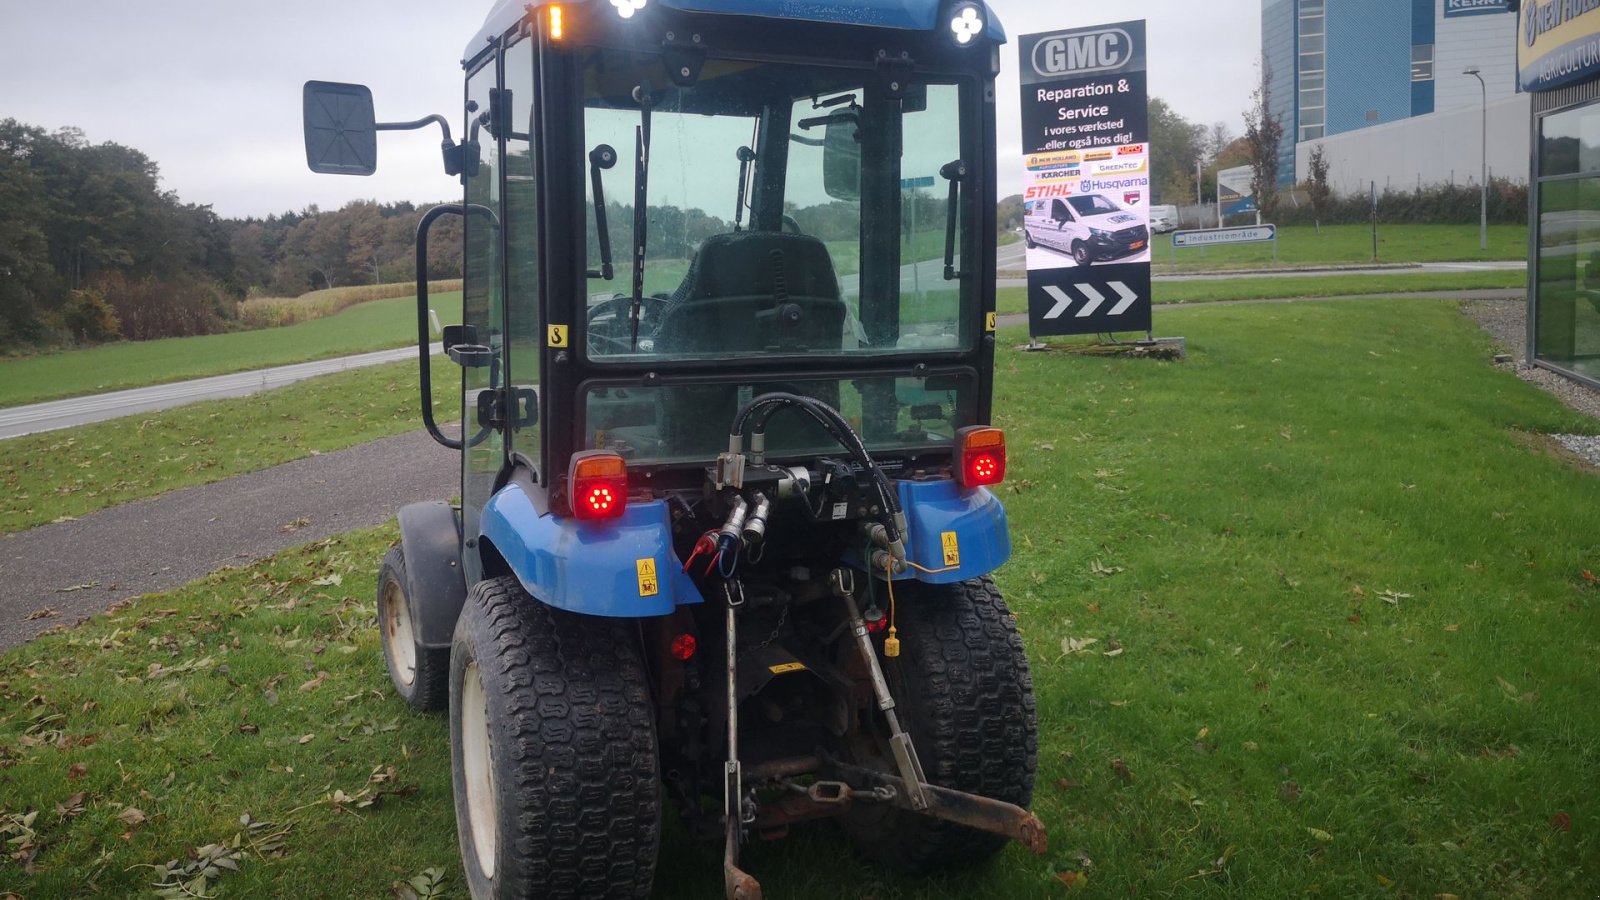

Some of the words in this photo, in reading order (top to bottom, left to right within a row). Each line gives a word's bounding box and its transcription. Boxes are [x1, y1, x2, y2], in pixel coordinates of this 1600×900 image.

[1045, 33, 1119, 73] GMC
[1538, 39, 1600, 84] AGRICULTUR
[1037, 83, 1113, 103] Reparation
[1117, 79, 1130, 93] &
[1058, 104, 1109, 121] Service
[1044, 126, 1048, 136] i
[1050, 125, 1077, 136] vores
[1078, 118, 1124, 134] værksted
[1068, 135, 1092, 149] også
[1093, 135, 1112, 146] hos
[1113, 131, 1133, 144] dig!
[1025, 184, 1072, 198] STIHL
[1092, 177, 1148, 190] Husqvarna
[1188, 231, 1258, 242] Industriområde
